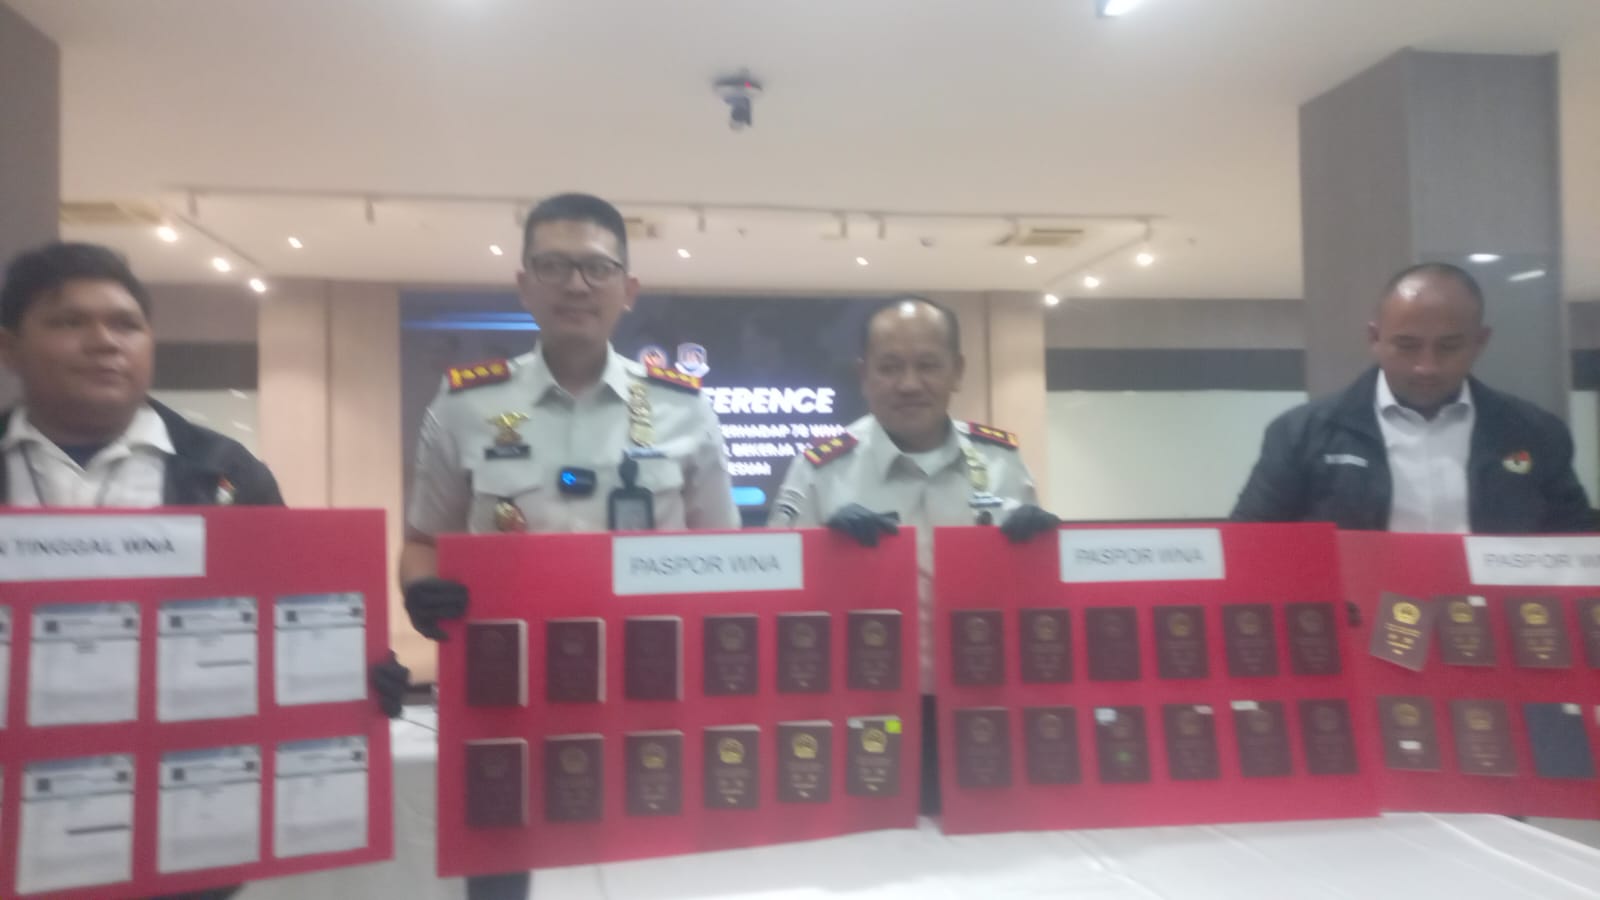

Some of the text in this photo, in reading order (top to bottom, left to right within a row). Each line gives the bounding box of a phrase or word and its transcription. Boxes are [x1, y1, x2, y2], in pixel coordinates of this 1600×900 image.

[630, 553, 782, 576] PASPOR WNA
[1074, 547, 1153, 565] PASPOR
[1483, 552, 1573, 569] PASPOR
